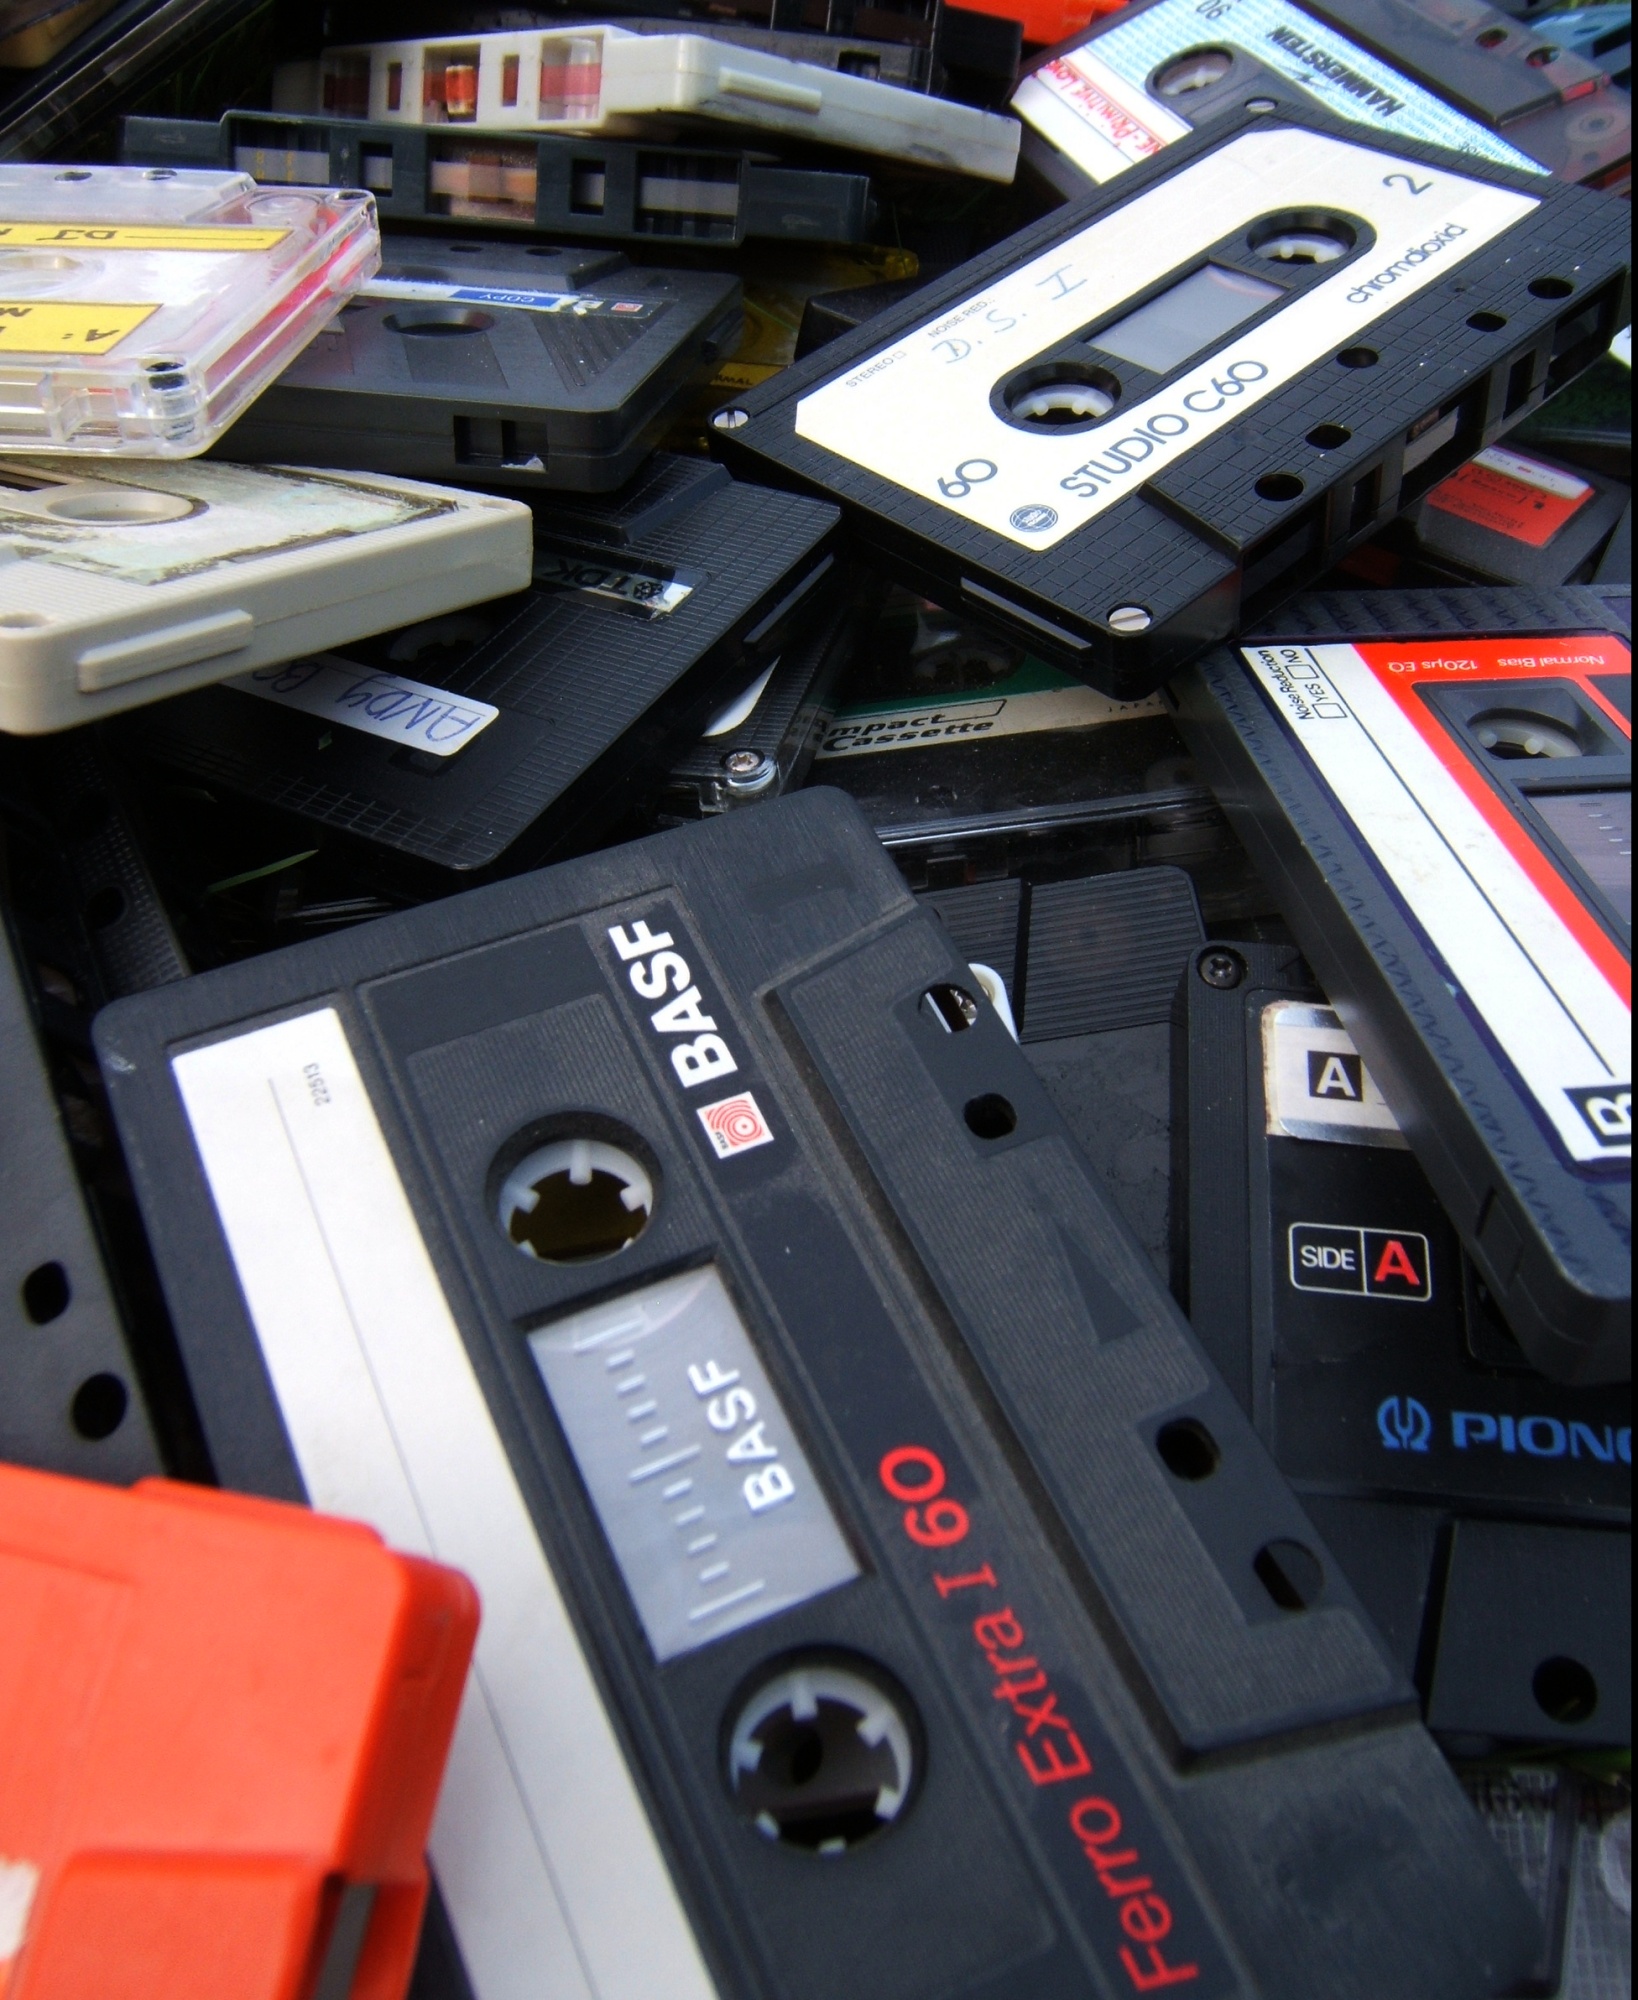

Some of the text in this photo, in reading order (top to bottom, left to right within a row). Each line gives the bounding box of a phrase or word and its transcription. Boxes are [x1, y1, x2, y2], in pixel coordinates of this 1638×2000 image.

[1265, 24, 1408, 118] HAMMERSTEIN
[1381, 173, 1434, 195] 2
[479, 291, 537, 304] COPY
[927, 314, 965, 339] NOISE
[845, 356, 895, 388] STEREO
[1059, 360, 1269, 498] STUDIO C60
[936, 458, 999, 499] 60
[542, 559, 631, 597] TDK
[1279, 648, 1303, 663] NO
[1387, 661, 1417, 673] EQ
[1497, 655, 1606, 669] Normal Bias
[1257, 650, 1315, 720] Noise Reduction
[1304, 683, 1329, 702] YES
[821, 720, 995, 753] Cassette
[607, 920, 740, 1090] BASF
[1315, 1056, 1357, 1098] A
[1585, 1092, 1631, 1136] B
[1300, 1239, 1421, 1287] SIDE A
[687, 1359, 796, 1514] BASF
[878, 1444, 971, 1549] 60
[972, 1605, 1093, 1787] Extra
[1068, 1796, 1199, 1992] Ferro
